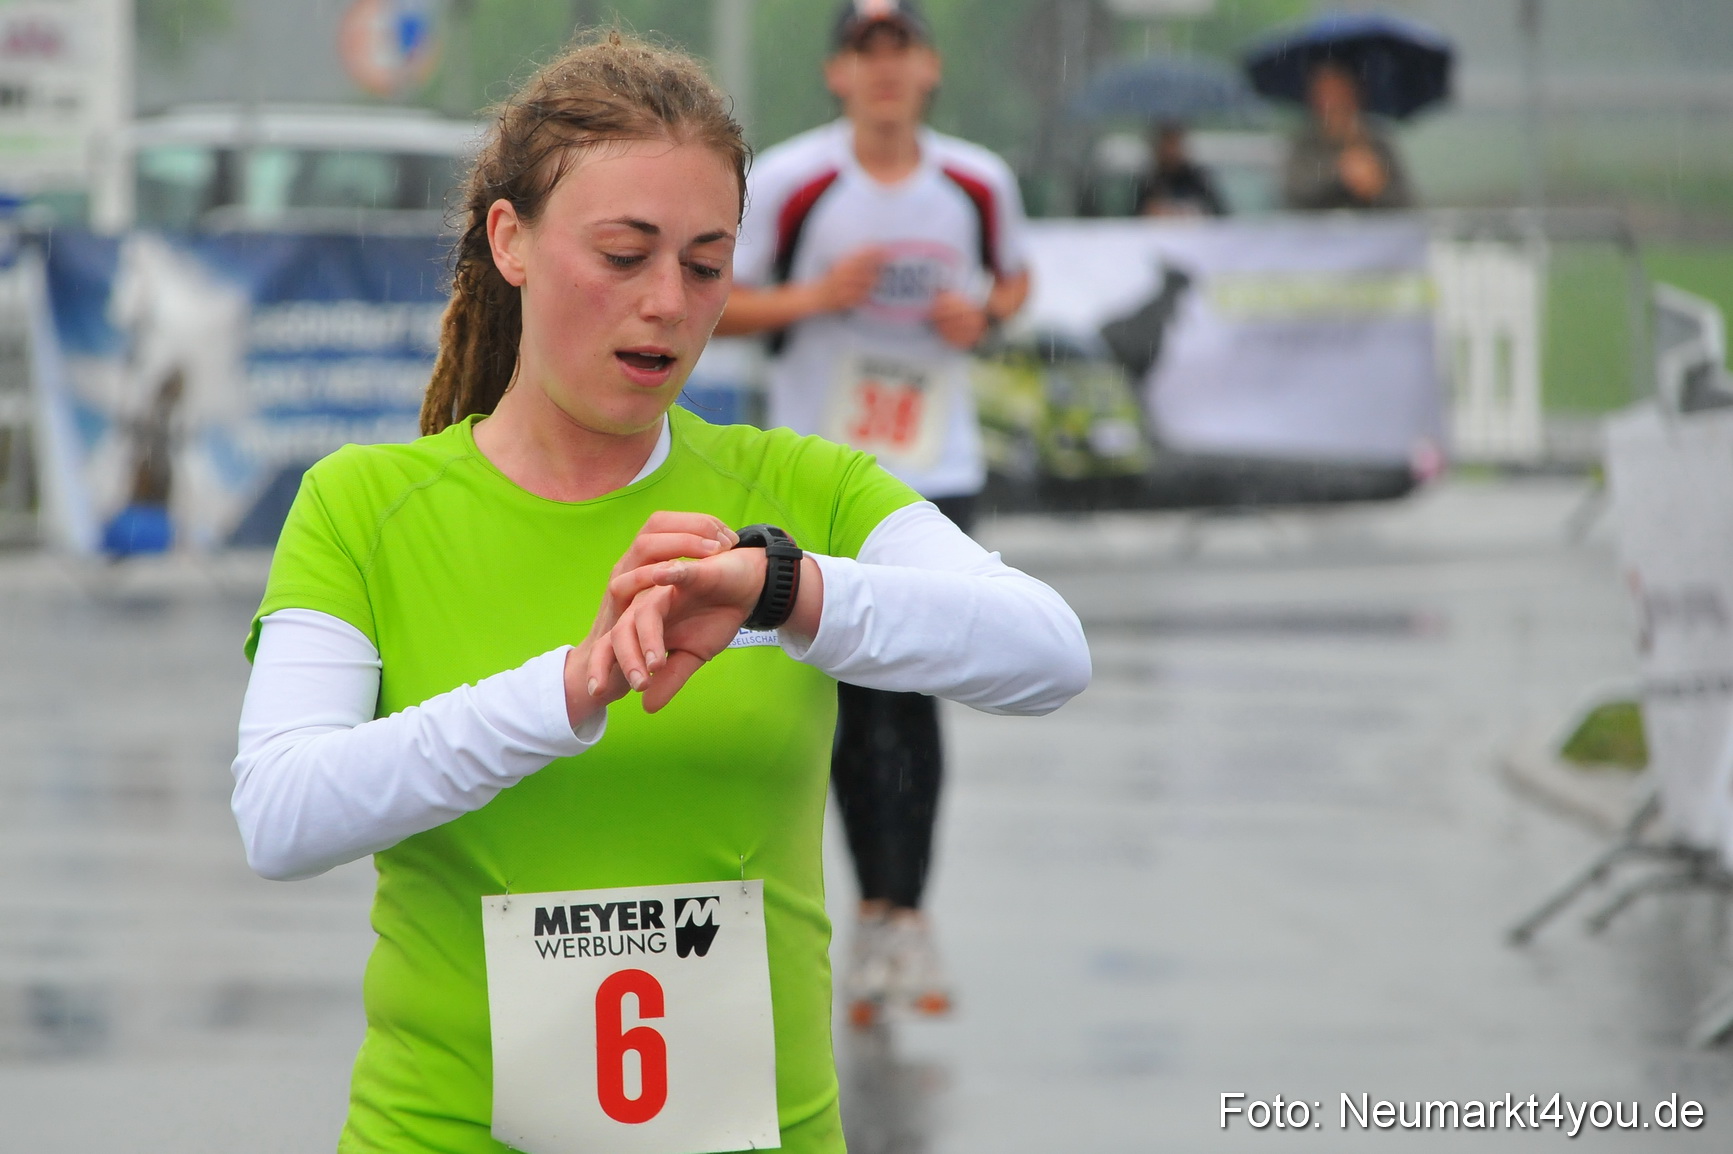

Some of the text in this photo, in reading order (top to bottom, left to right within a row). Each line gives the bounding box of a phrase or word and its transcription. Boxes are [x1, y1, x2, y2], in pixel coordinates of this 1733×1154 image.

[729, 635, 779, 646] SELLSCHAF
[534, 900, 666, 936] MEYER
[534, 932, 667, 960] WERBUNG
[595, 968, 668, 1125] 6
